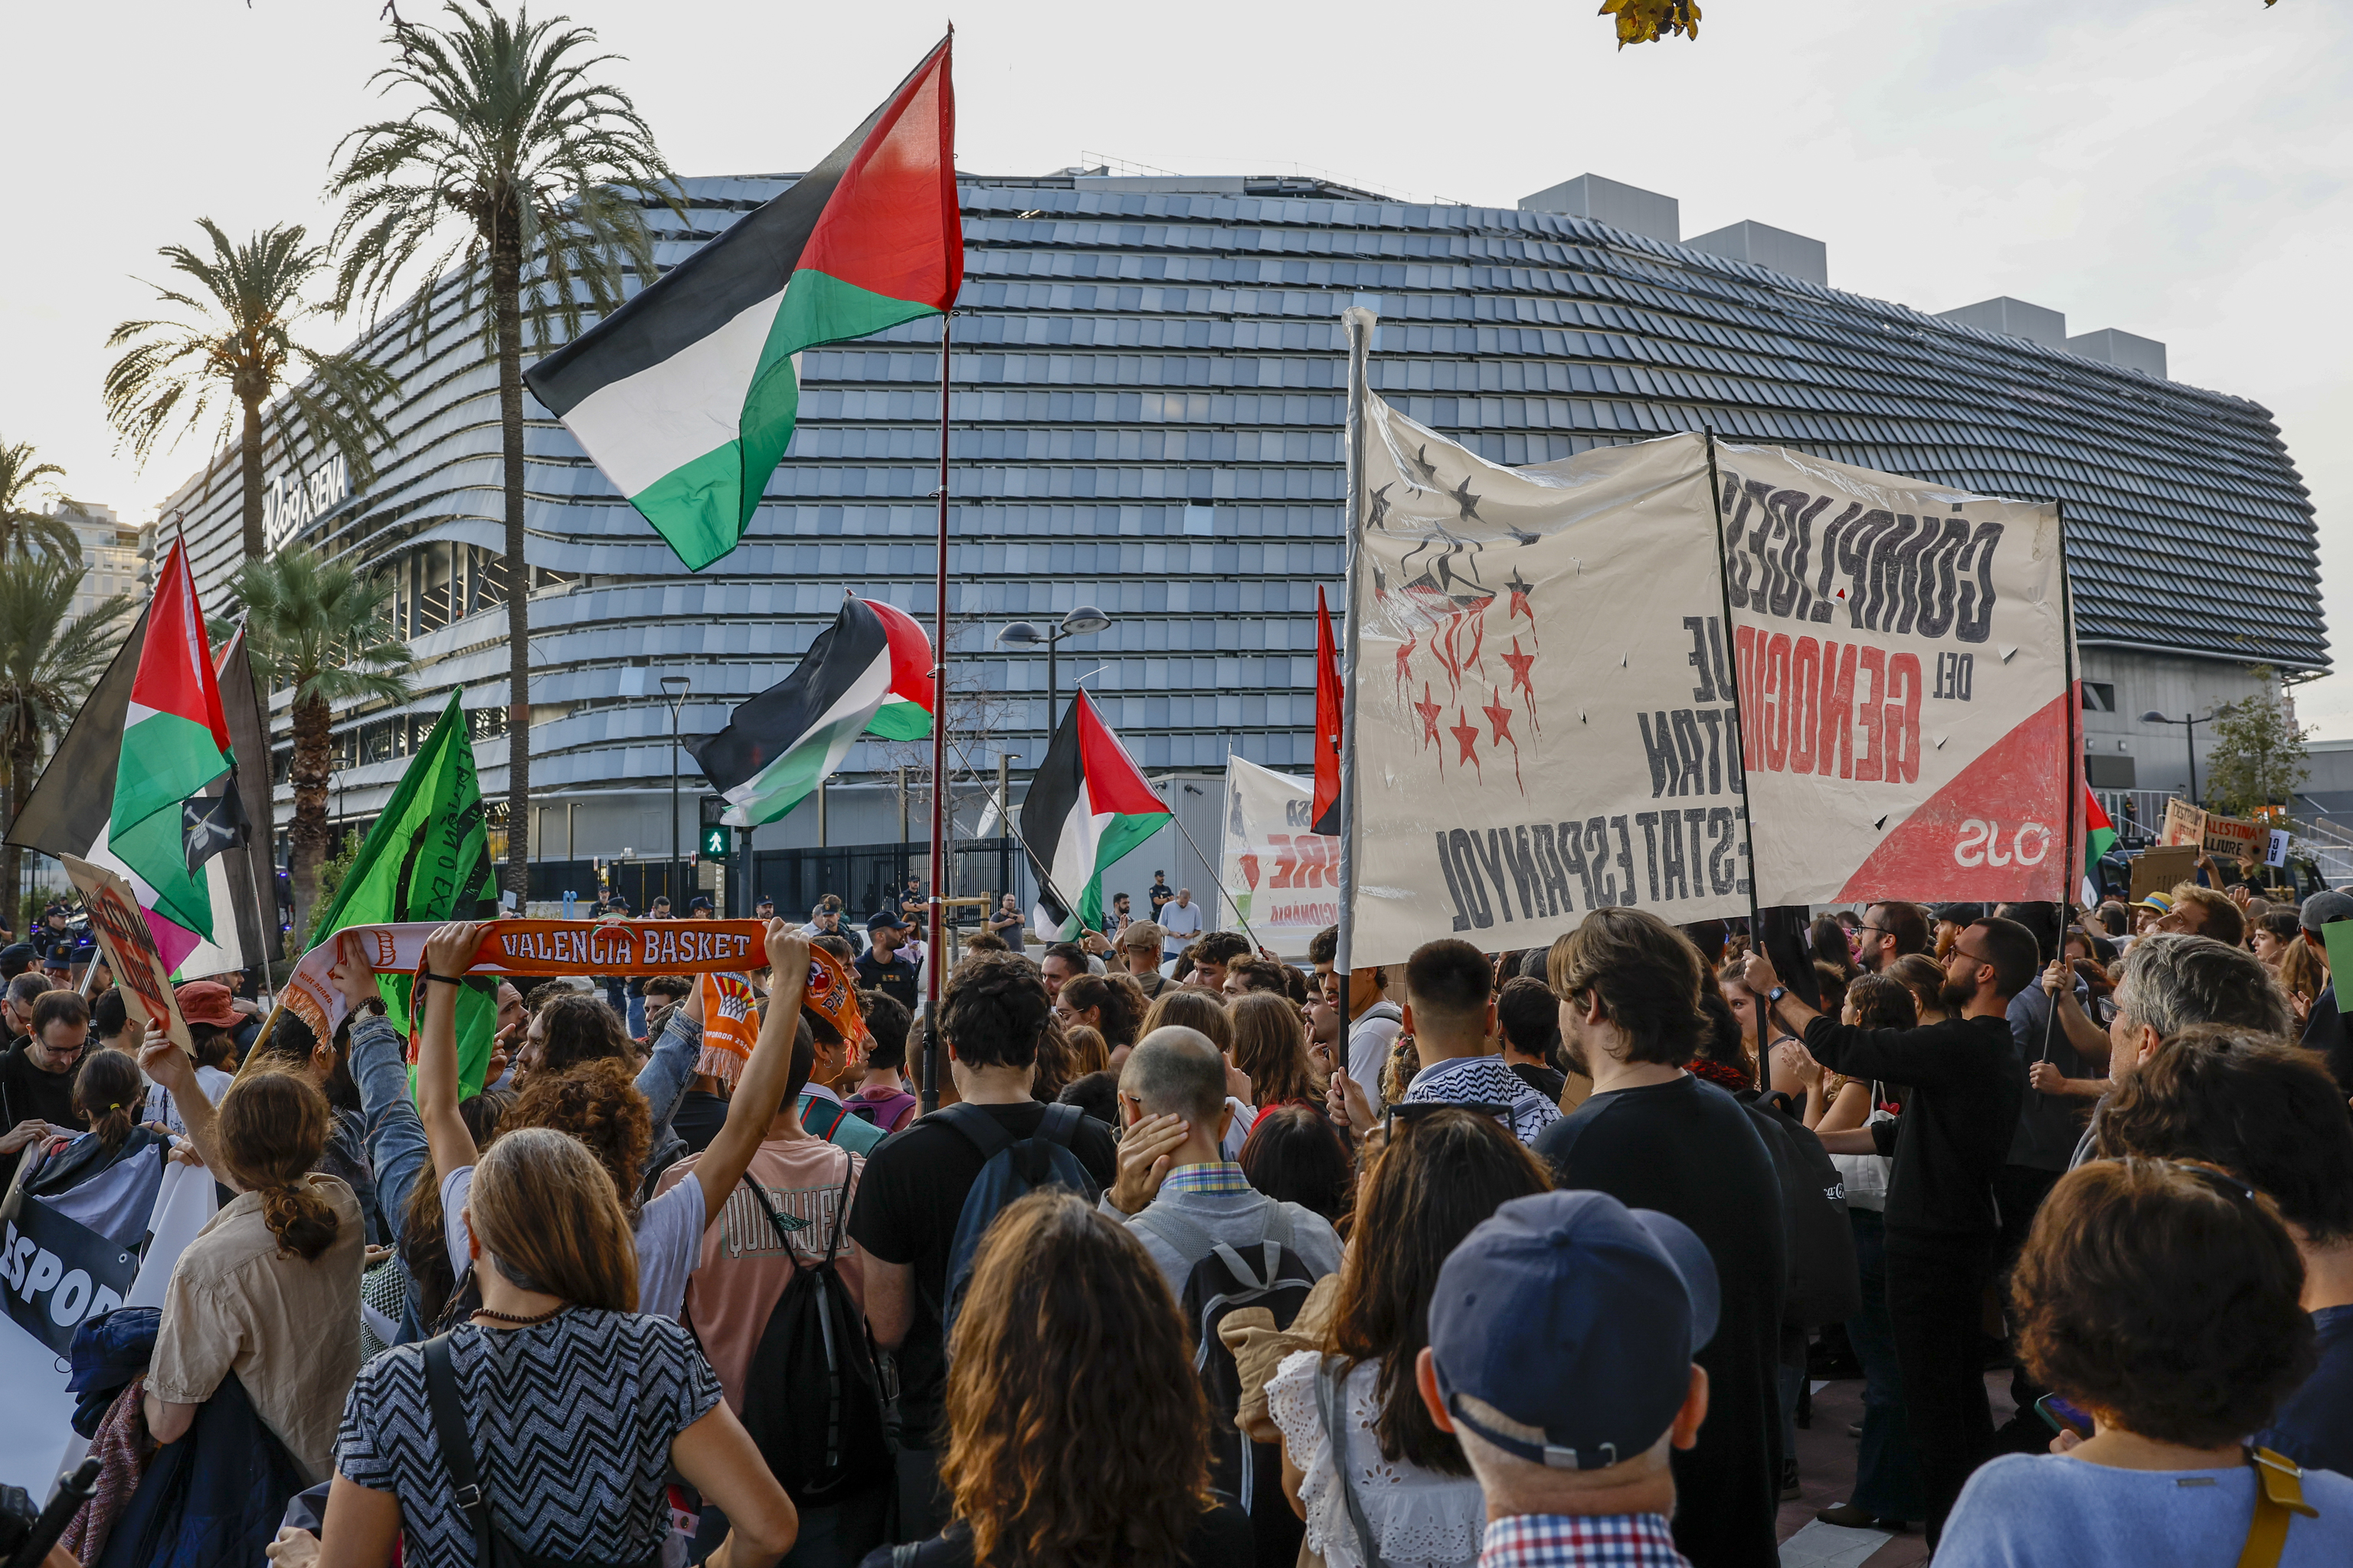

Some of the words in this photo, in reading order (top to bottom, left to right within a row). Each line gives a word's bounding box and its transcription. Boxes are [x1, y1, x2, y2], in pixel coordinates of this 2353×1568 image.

[262, 476, 303, 553] Roig
[299, 452, 346, 529] ARENA
[501, 930, 632, 964] VALENCIA
[642, 928, 751, 964] BASKET
